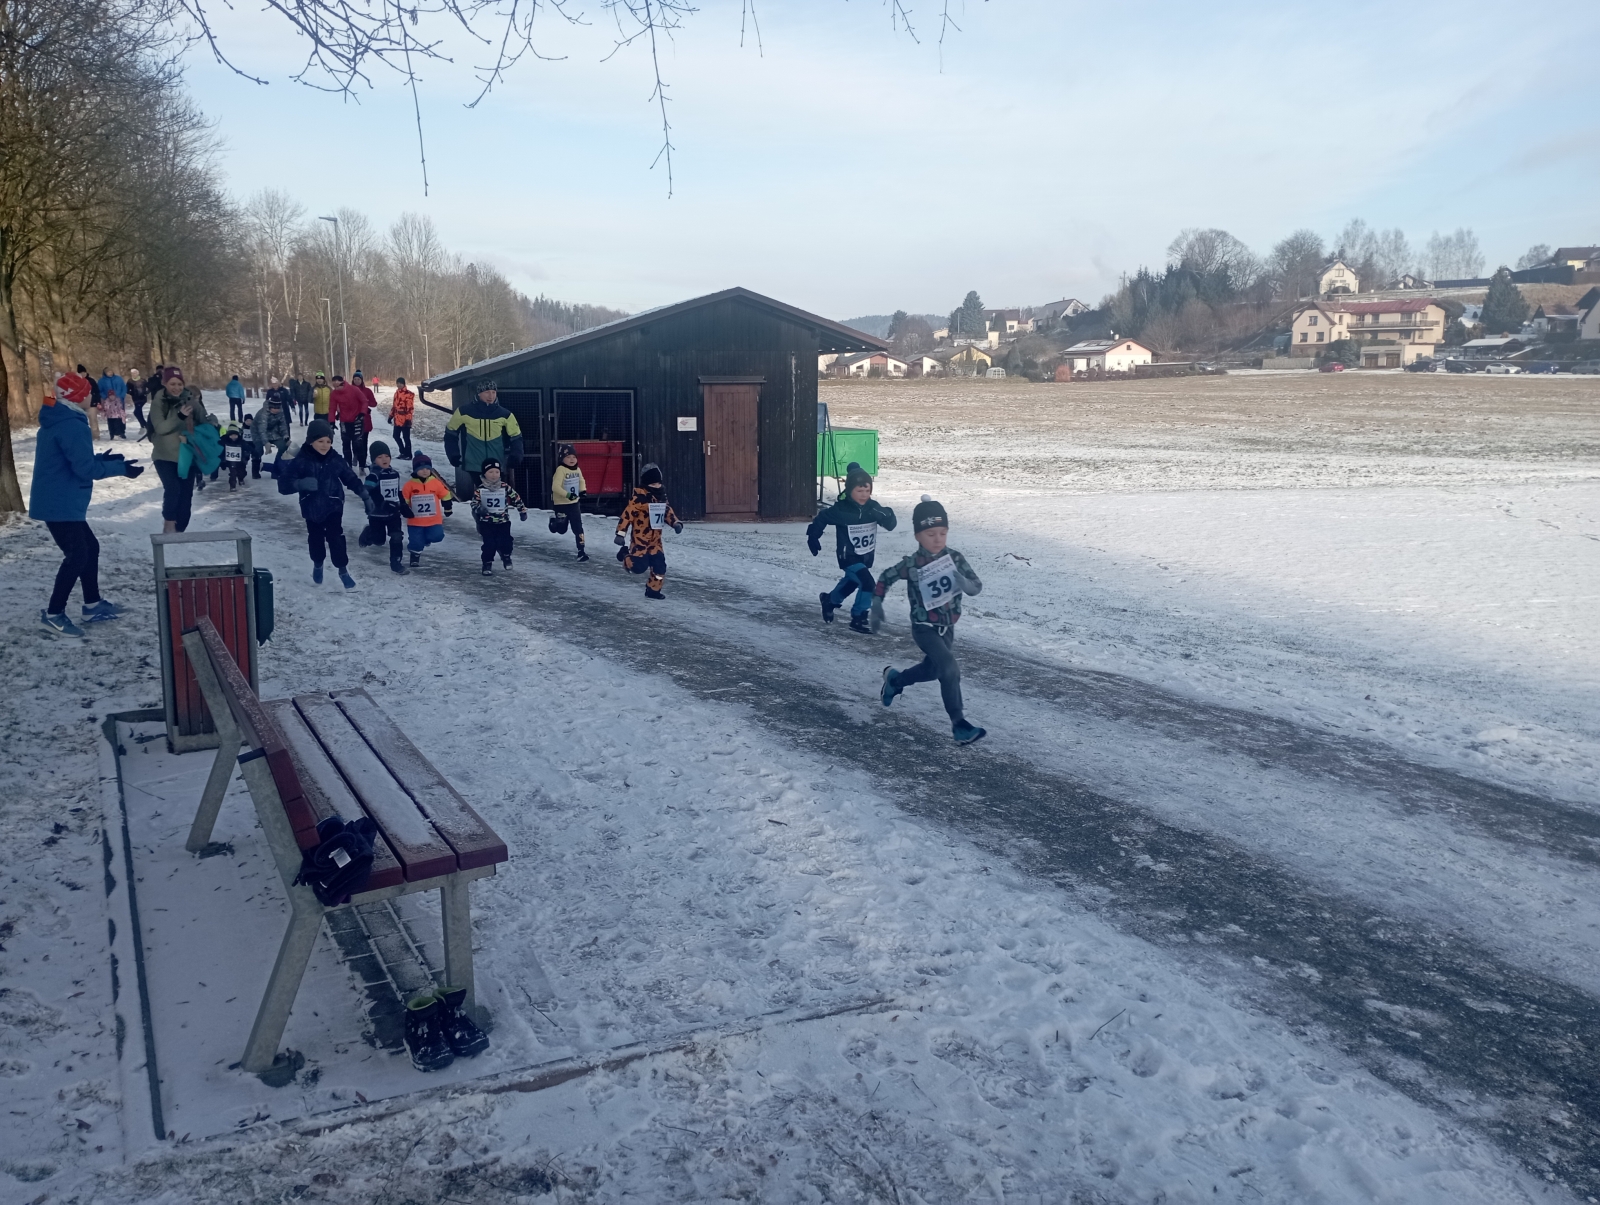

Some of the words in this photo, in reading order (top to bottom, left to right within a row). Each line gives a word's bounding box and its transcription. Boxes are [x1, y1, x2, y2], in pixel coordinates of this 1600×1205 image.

[417, 503, 431, 513] 22
[486, 498, 501, 508] 52
[852, 534, 874, 548] 262
[927, 576, 952, 598] 39
